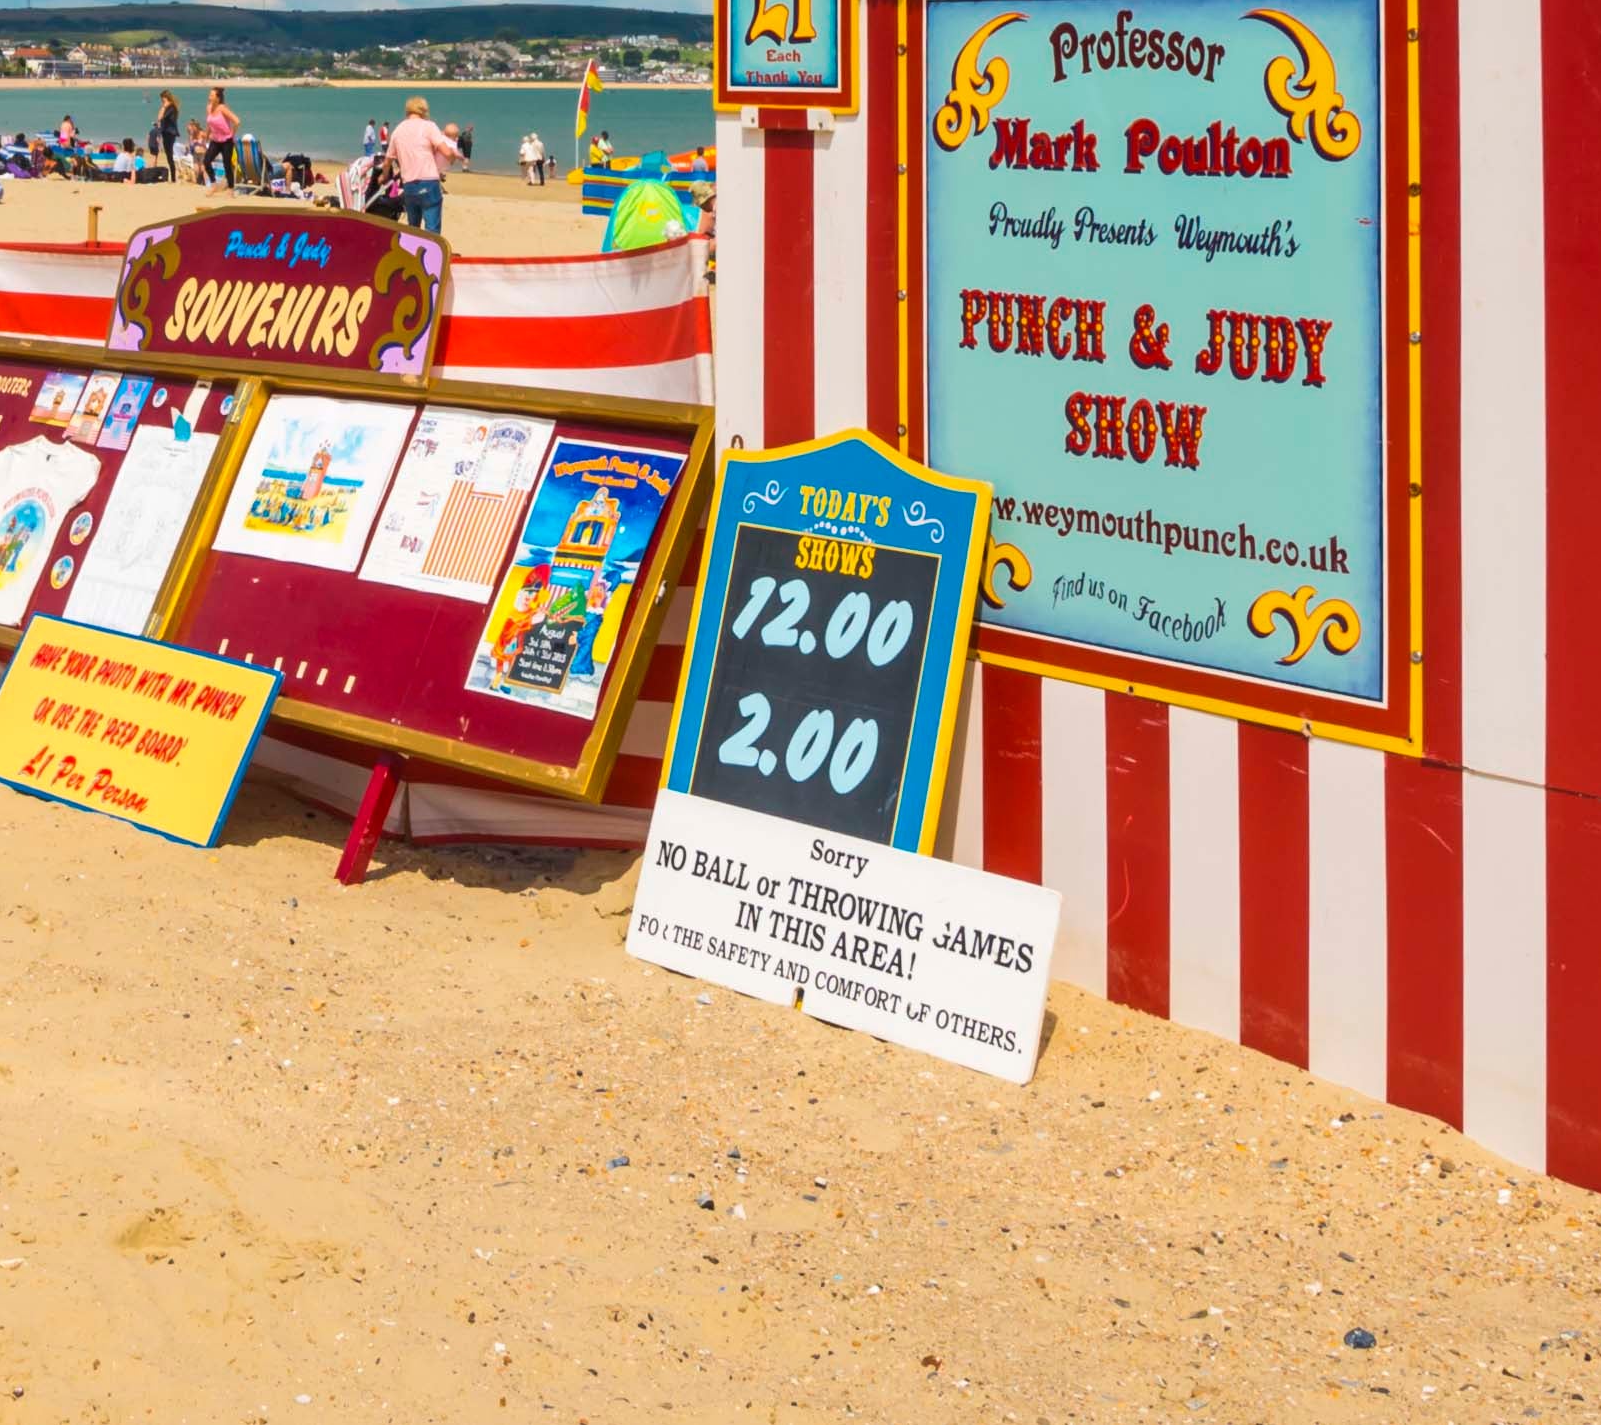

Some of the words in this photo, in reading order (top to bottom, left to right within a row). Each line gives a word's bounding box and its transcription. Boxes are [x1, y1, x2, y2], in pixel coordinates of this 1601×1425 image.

[746, 70, 788, 84] Thank
[797, 70, 822, 84] You
[766, 49, 801, 62] Each
[1050, 10, 1226, 83] Professor
[988, 117, 1101, 173] Mark
[1123, 117, 1293, 179] Poulton
[224, 229, 274, 259] Punch
[274, 232, 291, 260] &
[287, 231, 332, 269] Judy
[988, 201, 1066, 250] Proudly
[1073, 206, 1158, 247] Presents
[1174, 213, 1301, 263] Weymouth's
[164, 276, 374, 358] SOUVENIRS
[959, 289, 1107, 363] PUNCH
[1129, 303, 1173, 371] &
[1195, 309, 1333, 388] JUDY
[1064, 391, 1208, 471] SHOW
[798, 484, 894, 529] TODAY'S
[993, 495, 1350, 575] w.weymouthpunch.co.uk
[795, 532, 877, 581] SHOWS
[731, 576, 914, 668] 12.00
[1088, 576, 1106, 600] us
[1108, 588, 1128, 613] on
[1133, 595, 1228, 643] Facebook
[29, 642, 68, 672] HAVE
[60, 650, 99, 683] YOUR
[92, 659, 138, 691] PHOTO
[132, 668, 174, 702] WITH
[166, 678, 197, 709] MR
[190, 684, 247, 722] PUNCH
[32, 696, 56, 725] OR
[50, 702, 81, 731] USE
[74, 707, 104, 739] THE
[100, 716, 139, 750] 'PEEP
[718, 691, 880, 795] 2.00
[20, 744, 55, 780] £1
[51, 754, 85, 791] Per
[85, 768, 149, 814] Person
[655, 839, 687, 872] NO
[691, 849, 751, 891] BALL
[756, 875, 781, 900] or
[788, 876, 924, 942] THROWING
[810, 838, 870, 879] Sorry
[735, 900, 764, 933] IN
[769, 909, 827, 953] THIS
[830, 930, 917, 981] AREA!
[673, 924, 705, 951] THE
[706, 935, 772, 973] SAFETY
[773, 958, 810, 985] AND
[814, 970, 902, 1015] COMFORT
[935, 1008, 1023, 1055] OTHERS.
